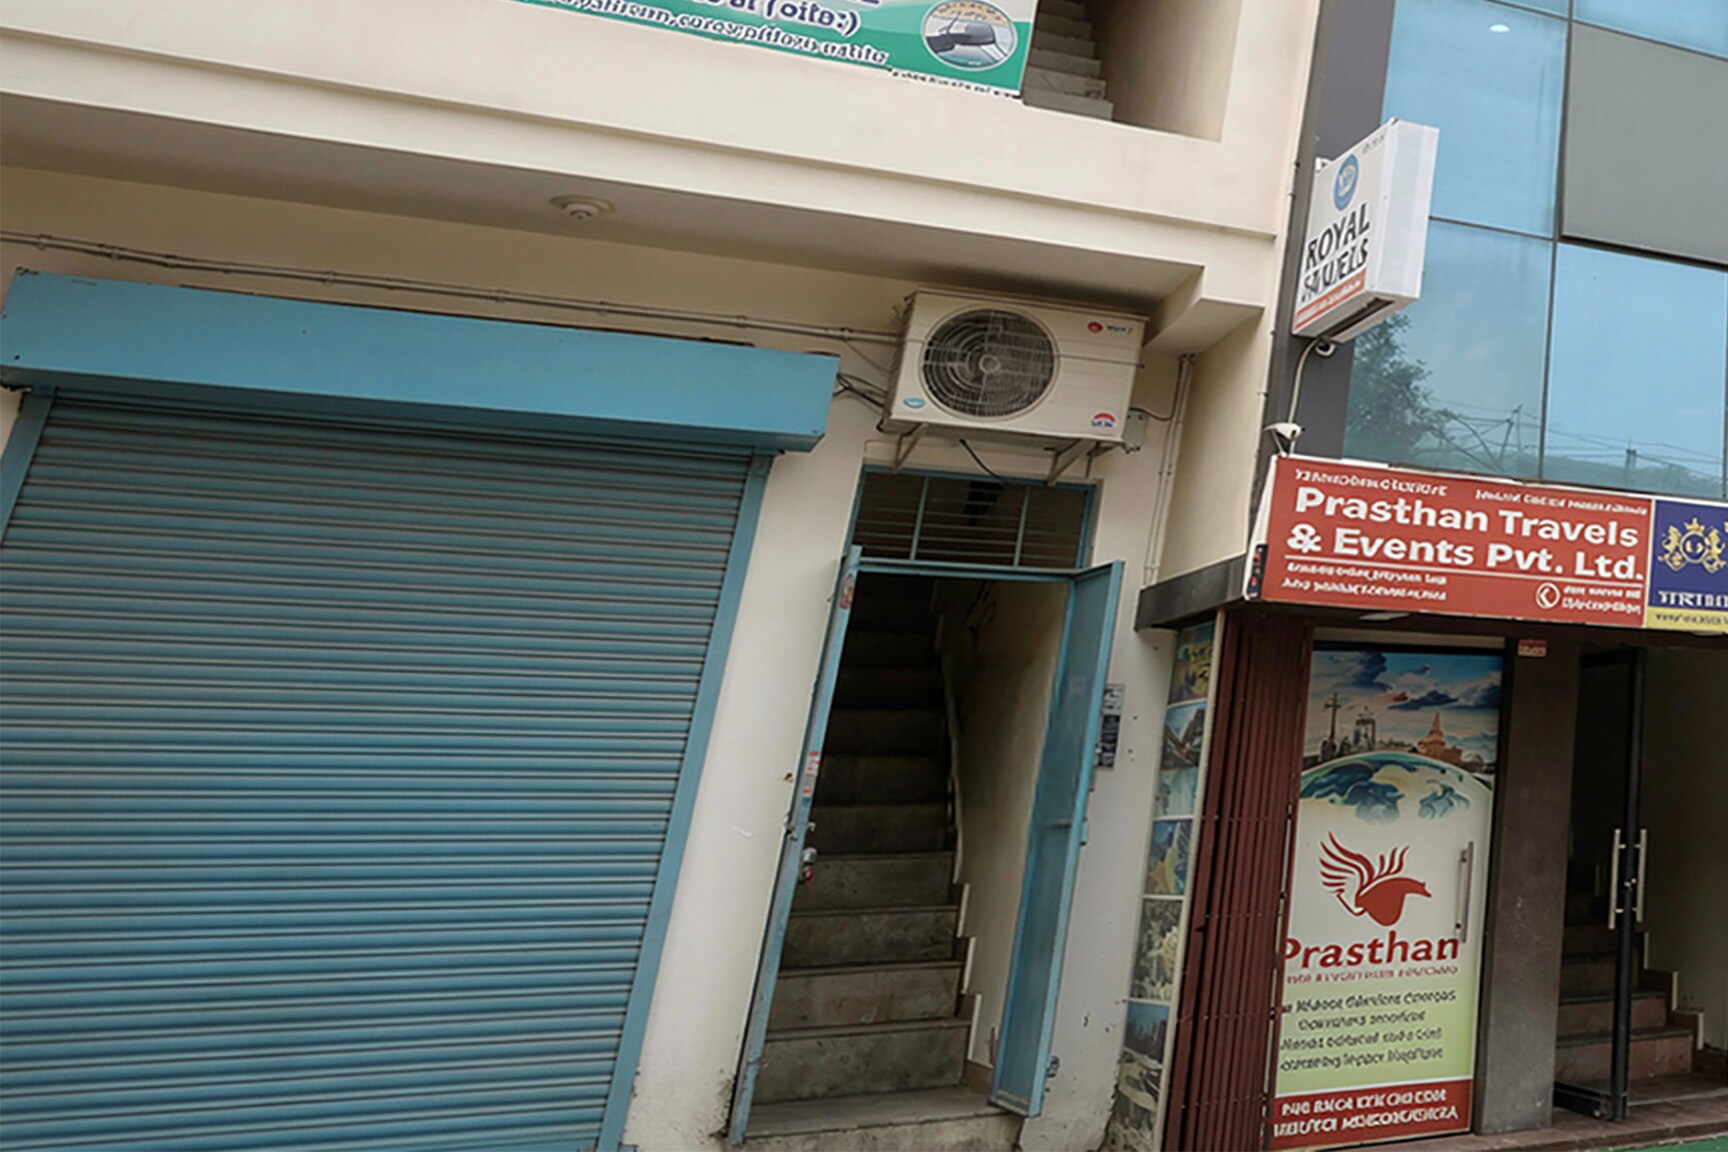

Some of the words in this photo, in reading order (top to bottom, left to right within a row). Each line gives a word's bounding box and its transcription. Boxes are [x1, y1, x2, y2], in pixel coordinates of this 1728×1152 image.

[1304, 202, 1370, 271] ROYAL
[1295, 486, 1489, 533] Prasthan
[1498, 509, 1639, 548] Travels
[1285, 523, 1323, 554] &
[1333, 527, 1475, 566] Events
[1486, 543, 1564, 574] Pvt.
[1574, 551, 1645, 581] Ltd.
[1285, 929, 1460, 969] Prasthan
